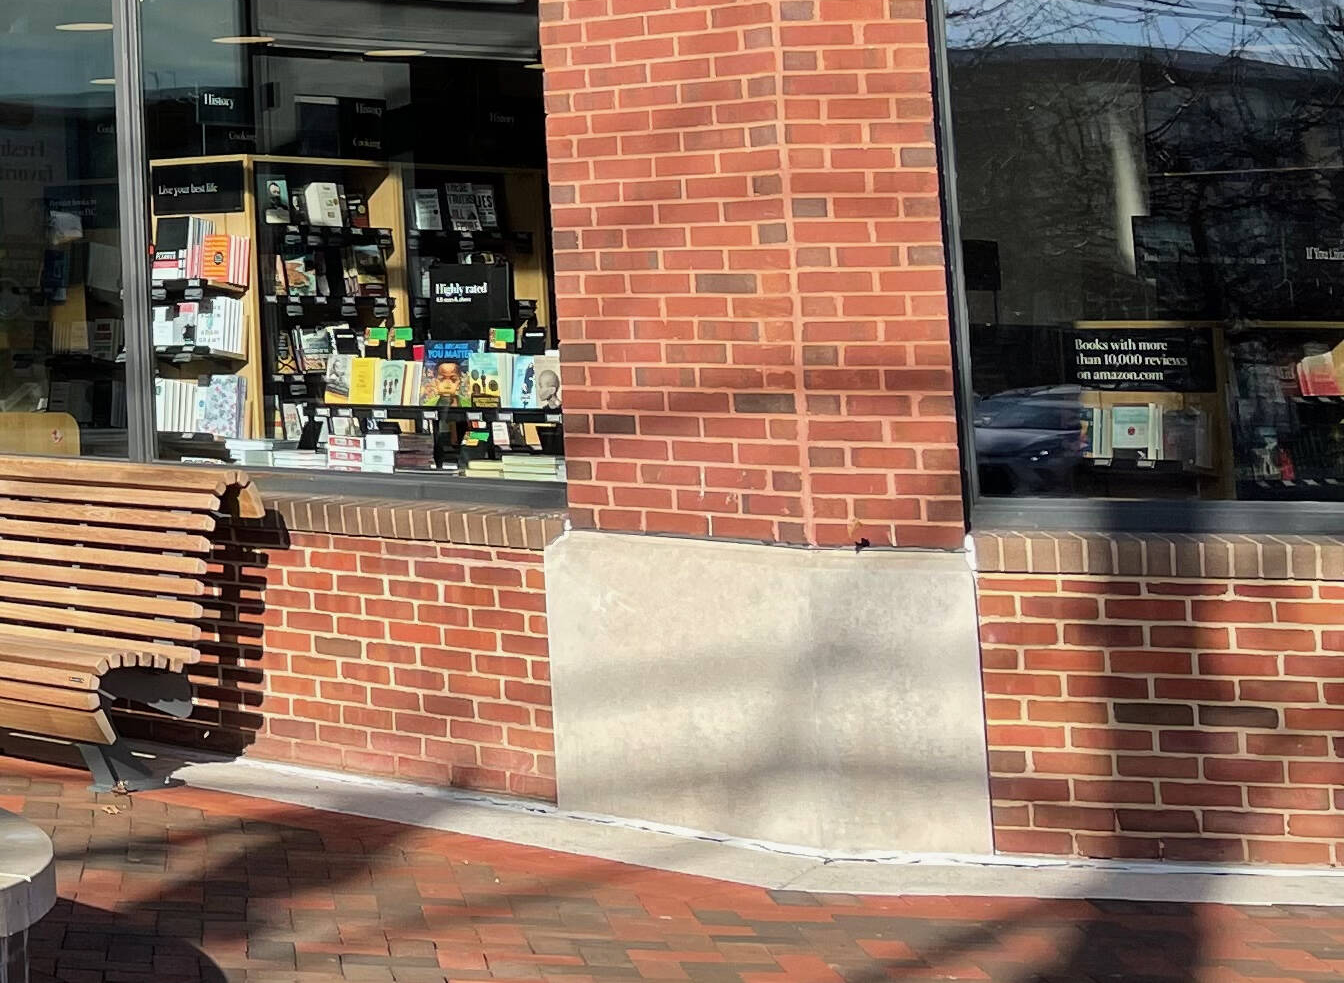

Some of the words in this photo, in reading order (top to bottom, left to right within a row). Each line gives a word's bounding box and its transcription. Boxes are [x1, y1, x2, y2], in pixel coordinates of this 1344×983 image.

[203, 93, 234, 110] History
[158, 184, 173, 196] Live
[174, 186, 190, 197] your
[191, 183, 205, 194] best
[206, 182, 218, 193] life
[435, 282, 463, 297] Highly
[465, 282, 488, 294] rated
[1074, 338, 1109, 351] Books
[1110, 338, 1137, 351] with
[1139, 342, 1168, 351] more
[428, 349, 443, 359] YOU
[1076, 352, 1101, 365] than
[1104, 353, 1143, 367] 10,000
[1144, 354, 1188, 366] reviews
[1076, 371, 1092, 380] on
[1093, 370, 1164, 380] amazon.com
